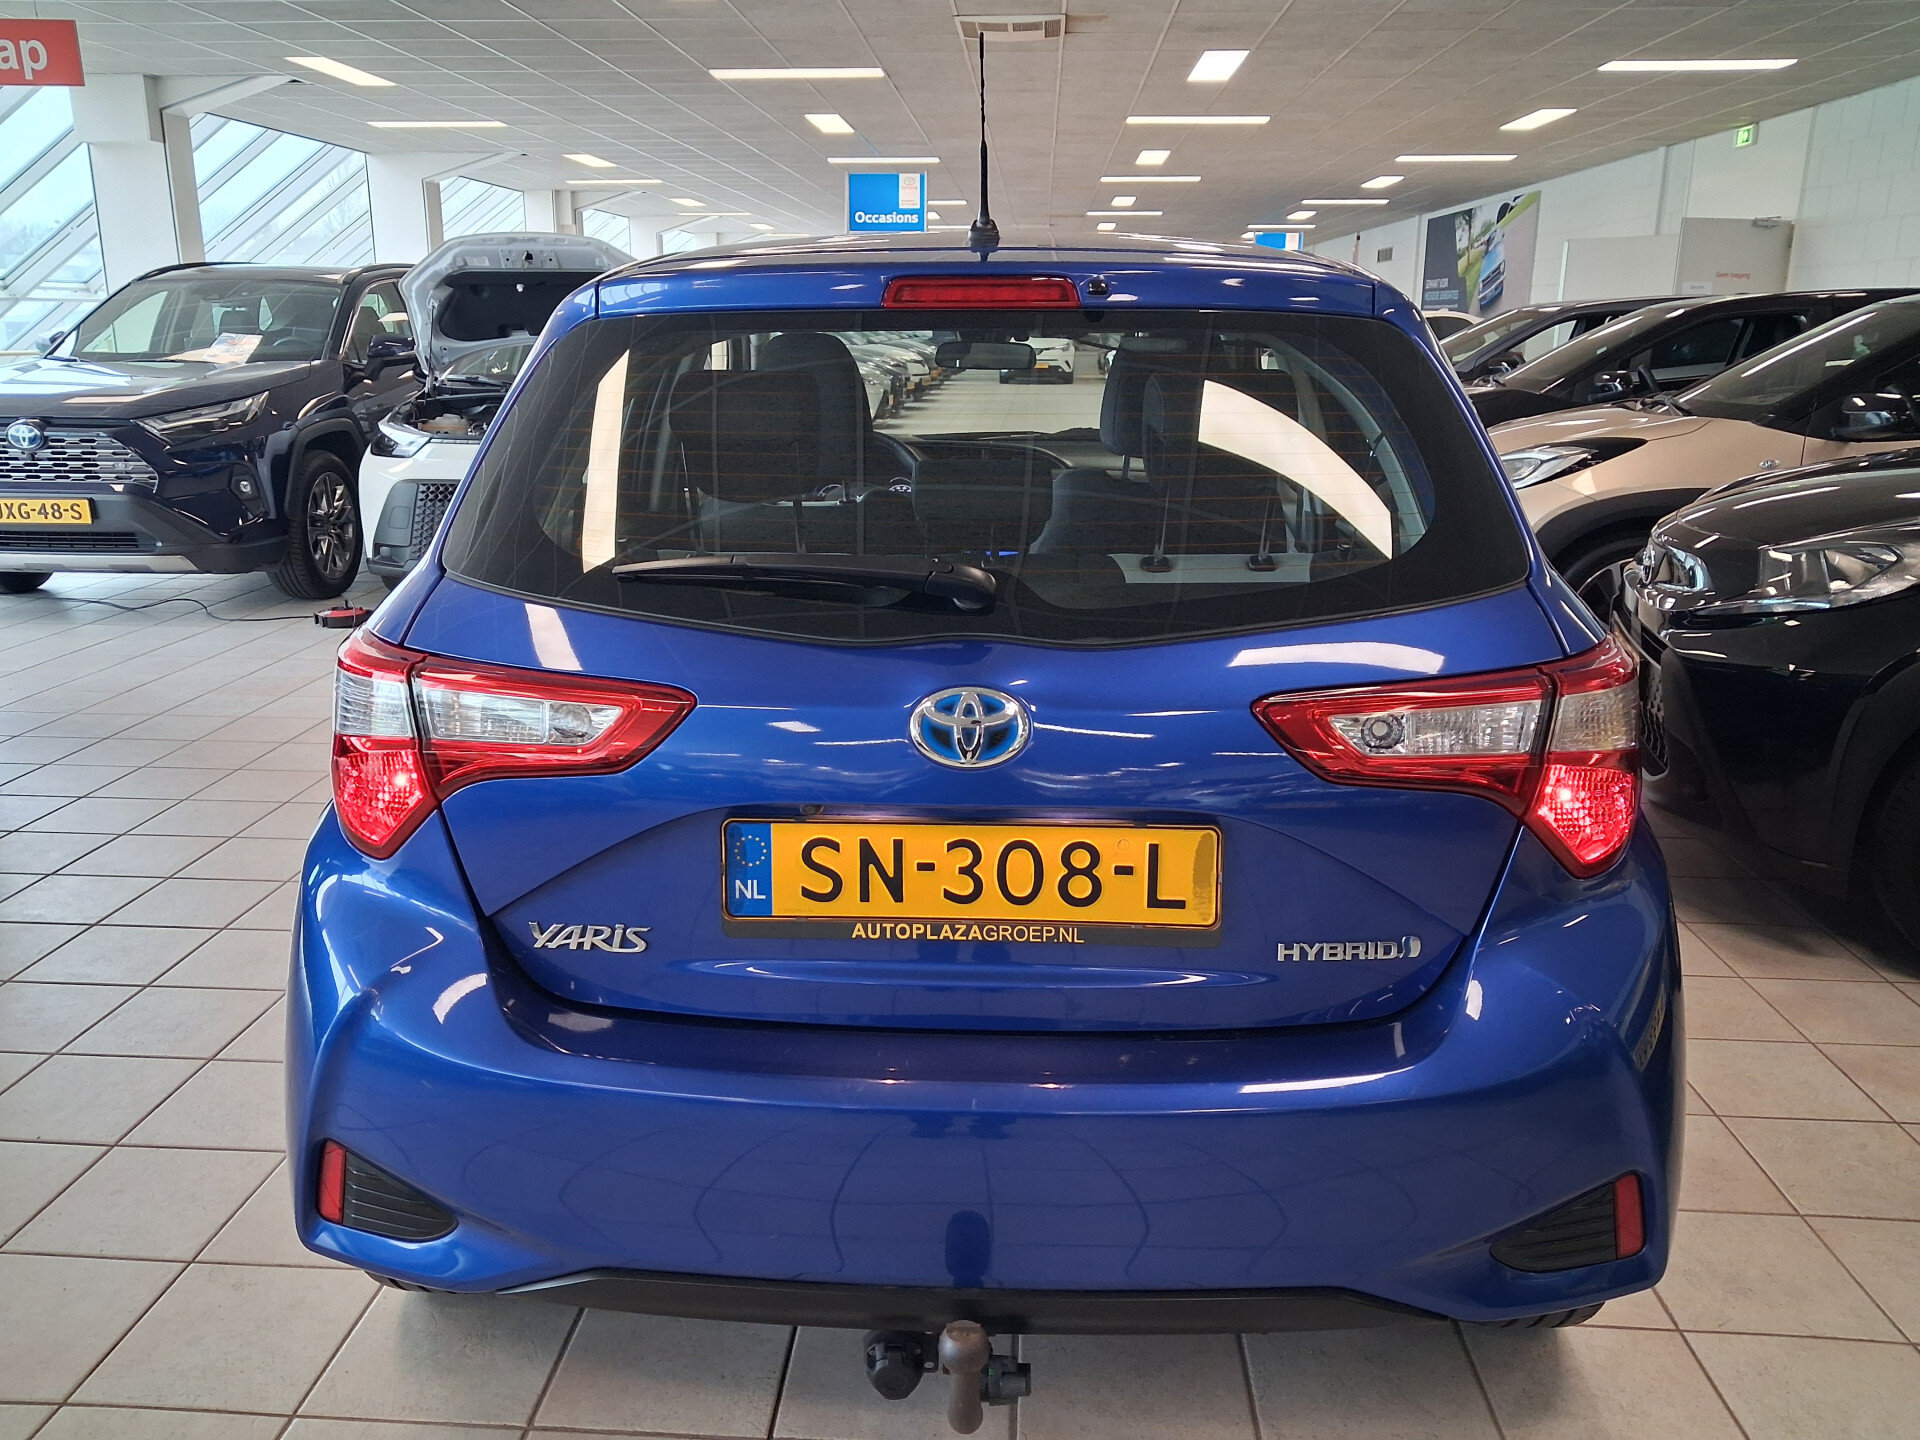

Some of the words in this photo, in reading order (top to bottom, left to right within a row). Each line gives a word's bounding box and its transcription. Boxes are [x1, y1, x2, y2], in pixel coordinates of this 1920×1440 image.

[0, 39, 48, 80] ap
[854, 211, 919, 224] Occasions
[0, 502, 82, 520] XG-48-S
[735, 879, 767, 899] NL
[800, 836, 1187, 909] SN-308-L
[851, 922, 1085, 943] AUTOPLAZAGROEP.NL
[1277, 941, 1398, 962] HYBRID
